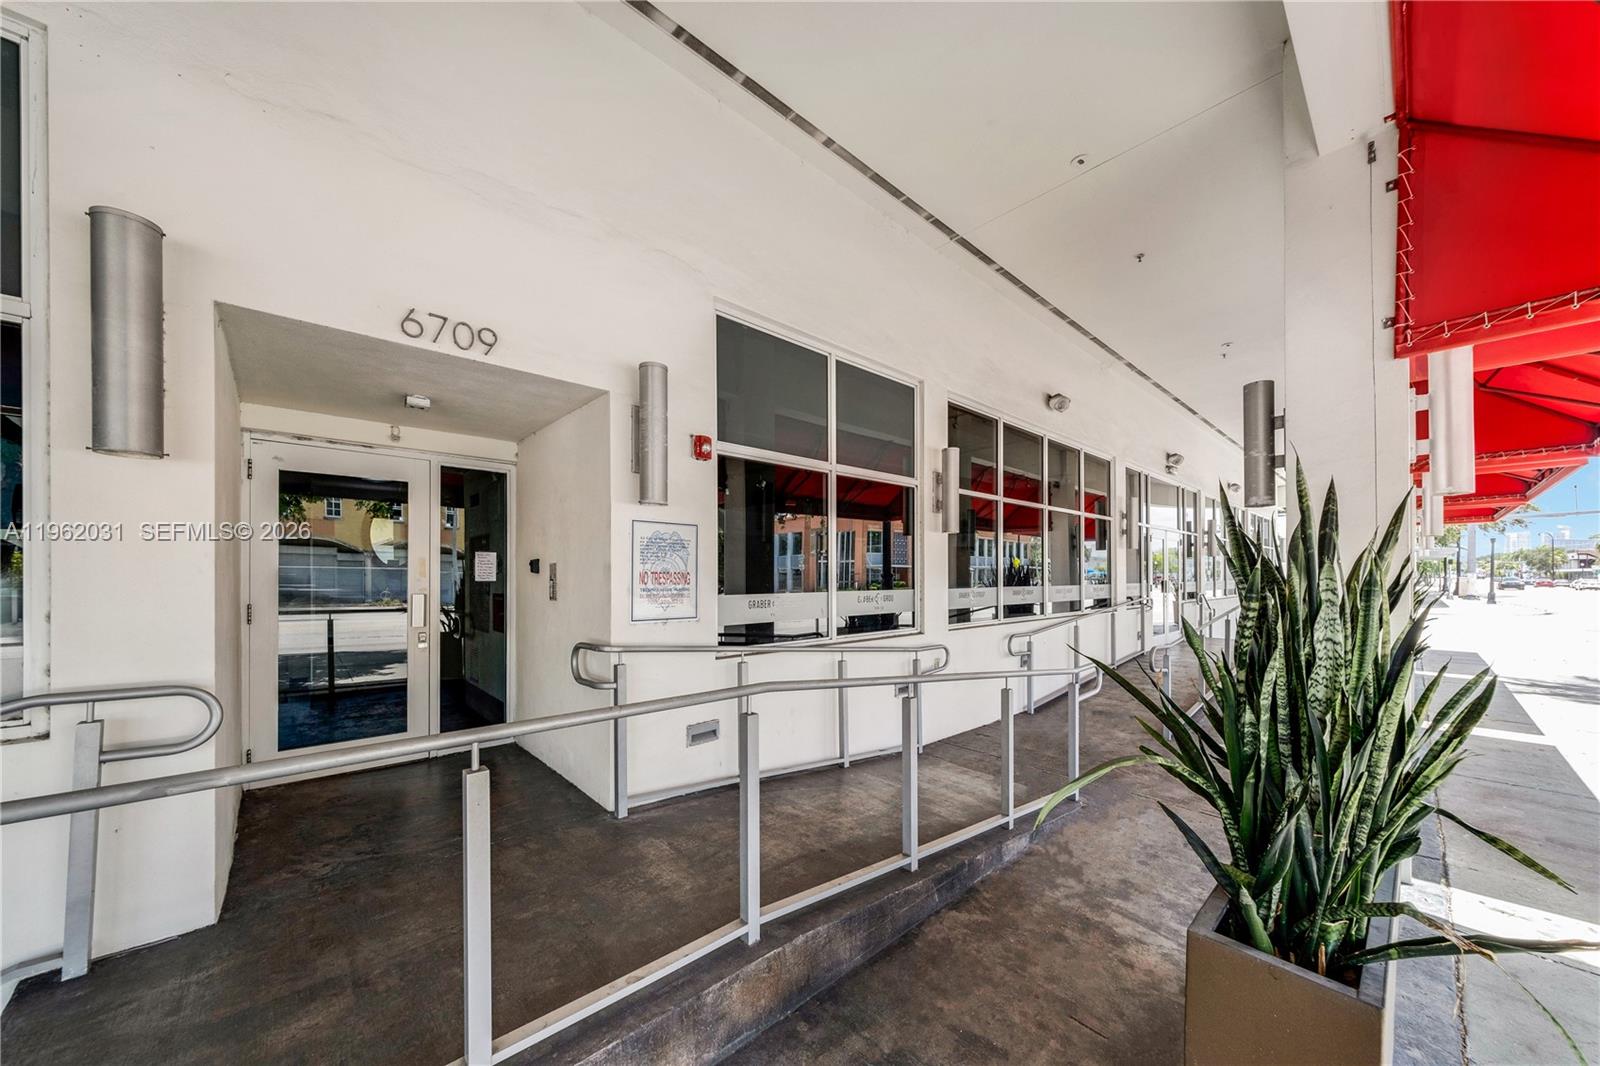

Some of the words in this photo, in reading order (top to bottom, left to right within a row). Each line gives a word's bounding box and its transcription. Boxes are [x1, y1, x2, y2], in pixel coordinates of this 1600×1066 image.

[400, 307, 498, 356] 6709
[638, 570, 649, 586] NO
[650, 571, 691, 586] TRESPASSING
[747, 599, 772, 609] GRABER
